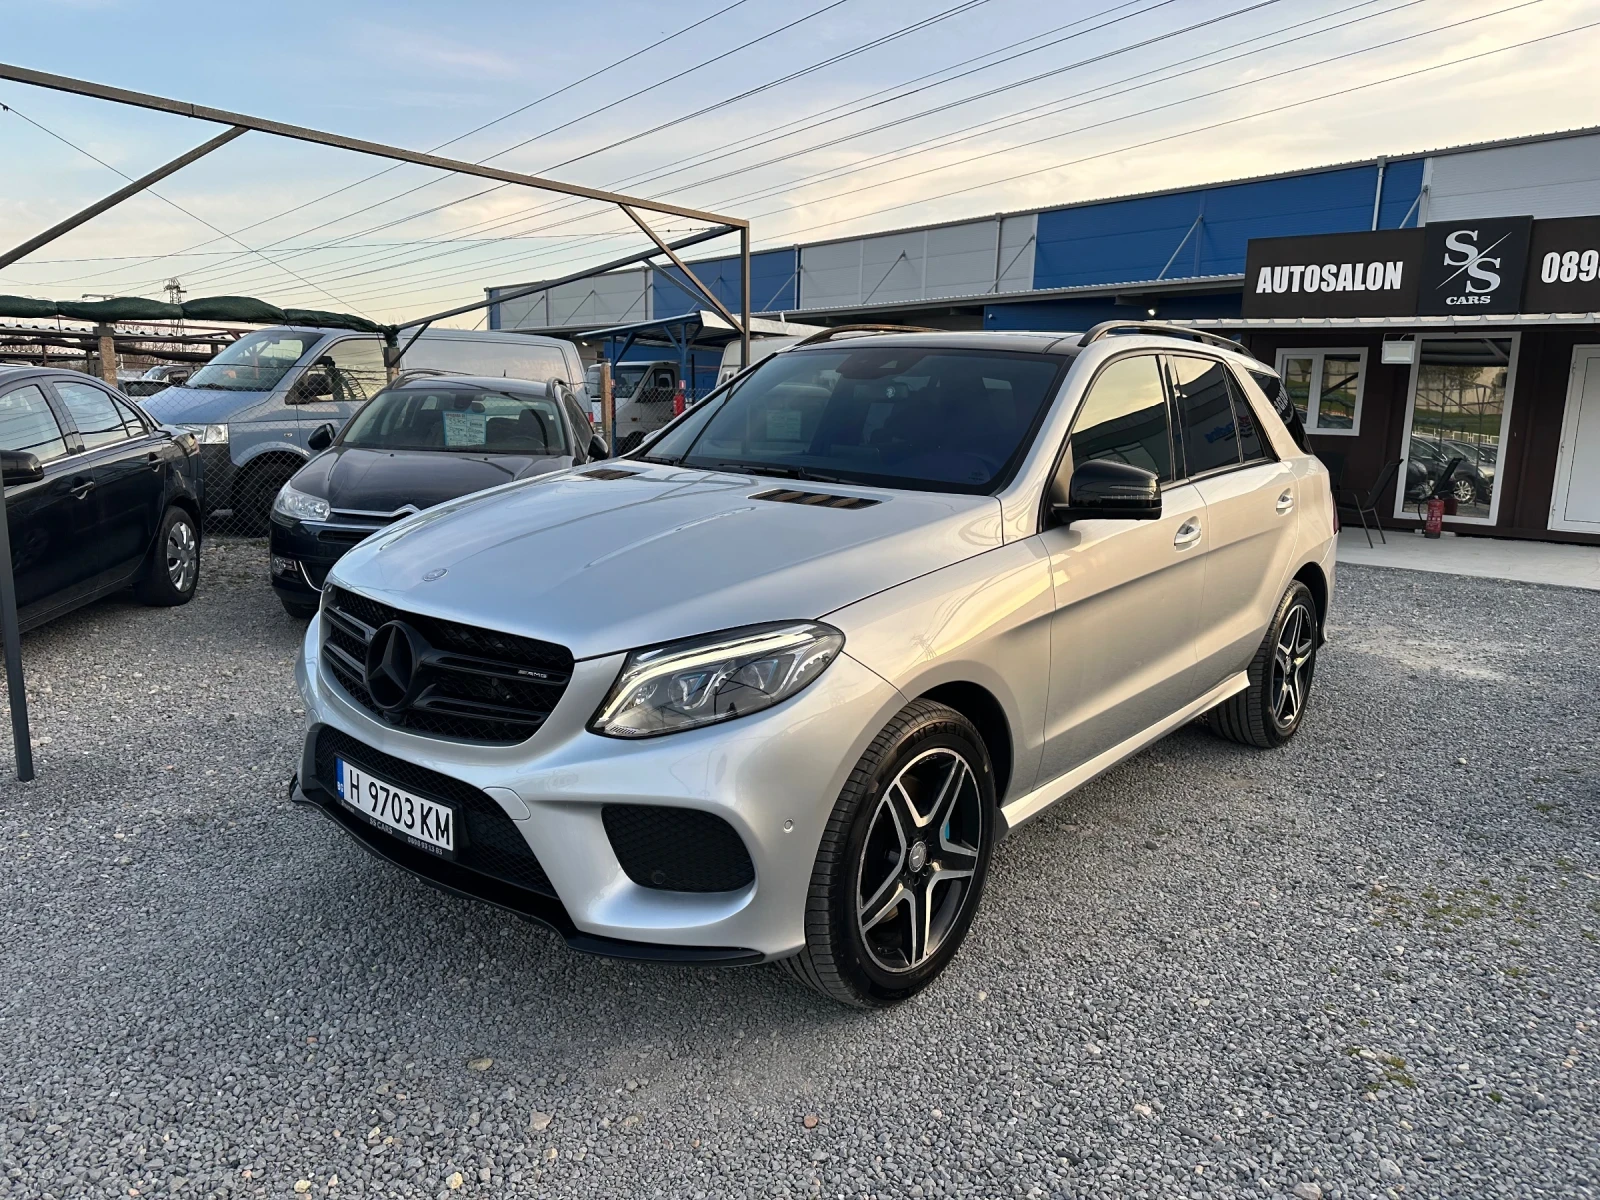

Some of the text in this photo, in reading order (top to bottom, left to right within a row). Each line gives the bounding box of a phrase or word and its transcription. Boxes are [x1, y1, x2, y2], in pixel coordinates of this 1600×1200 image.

[1541, 249, 1600, 284] 089
[1255, 261, 1404, 294] AUTOSALON
[1445, 295, 1491, 305] CARS
[527, 671, 548, 679] AMG
[337, 781, 344, 793] BG
[377, 820, 393, 835] CARS
